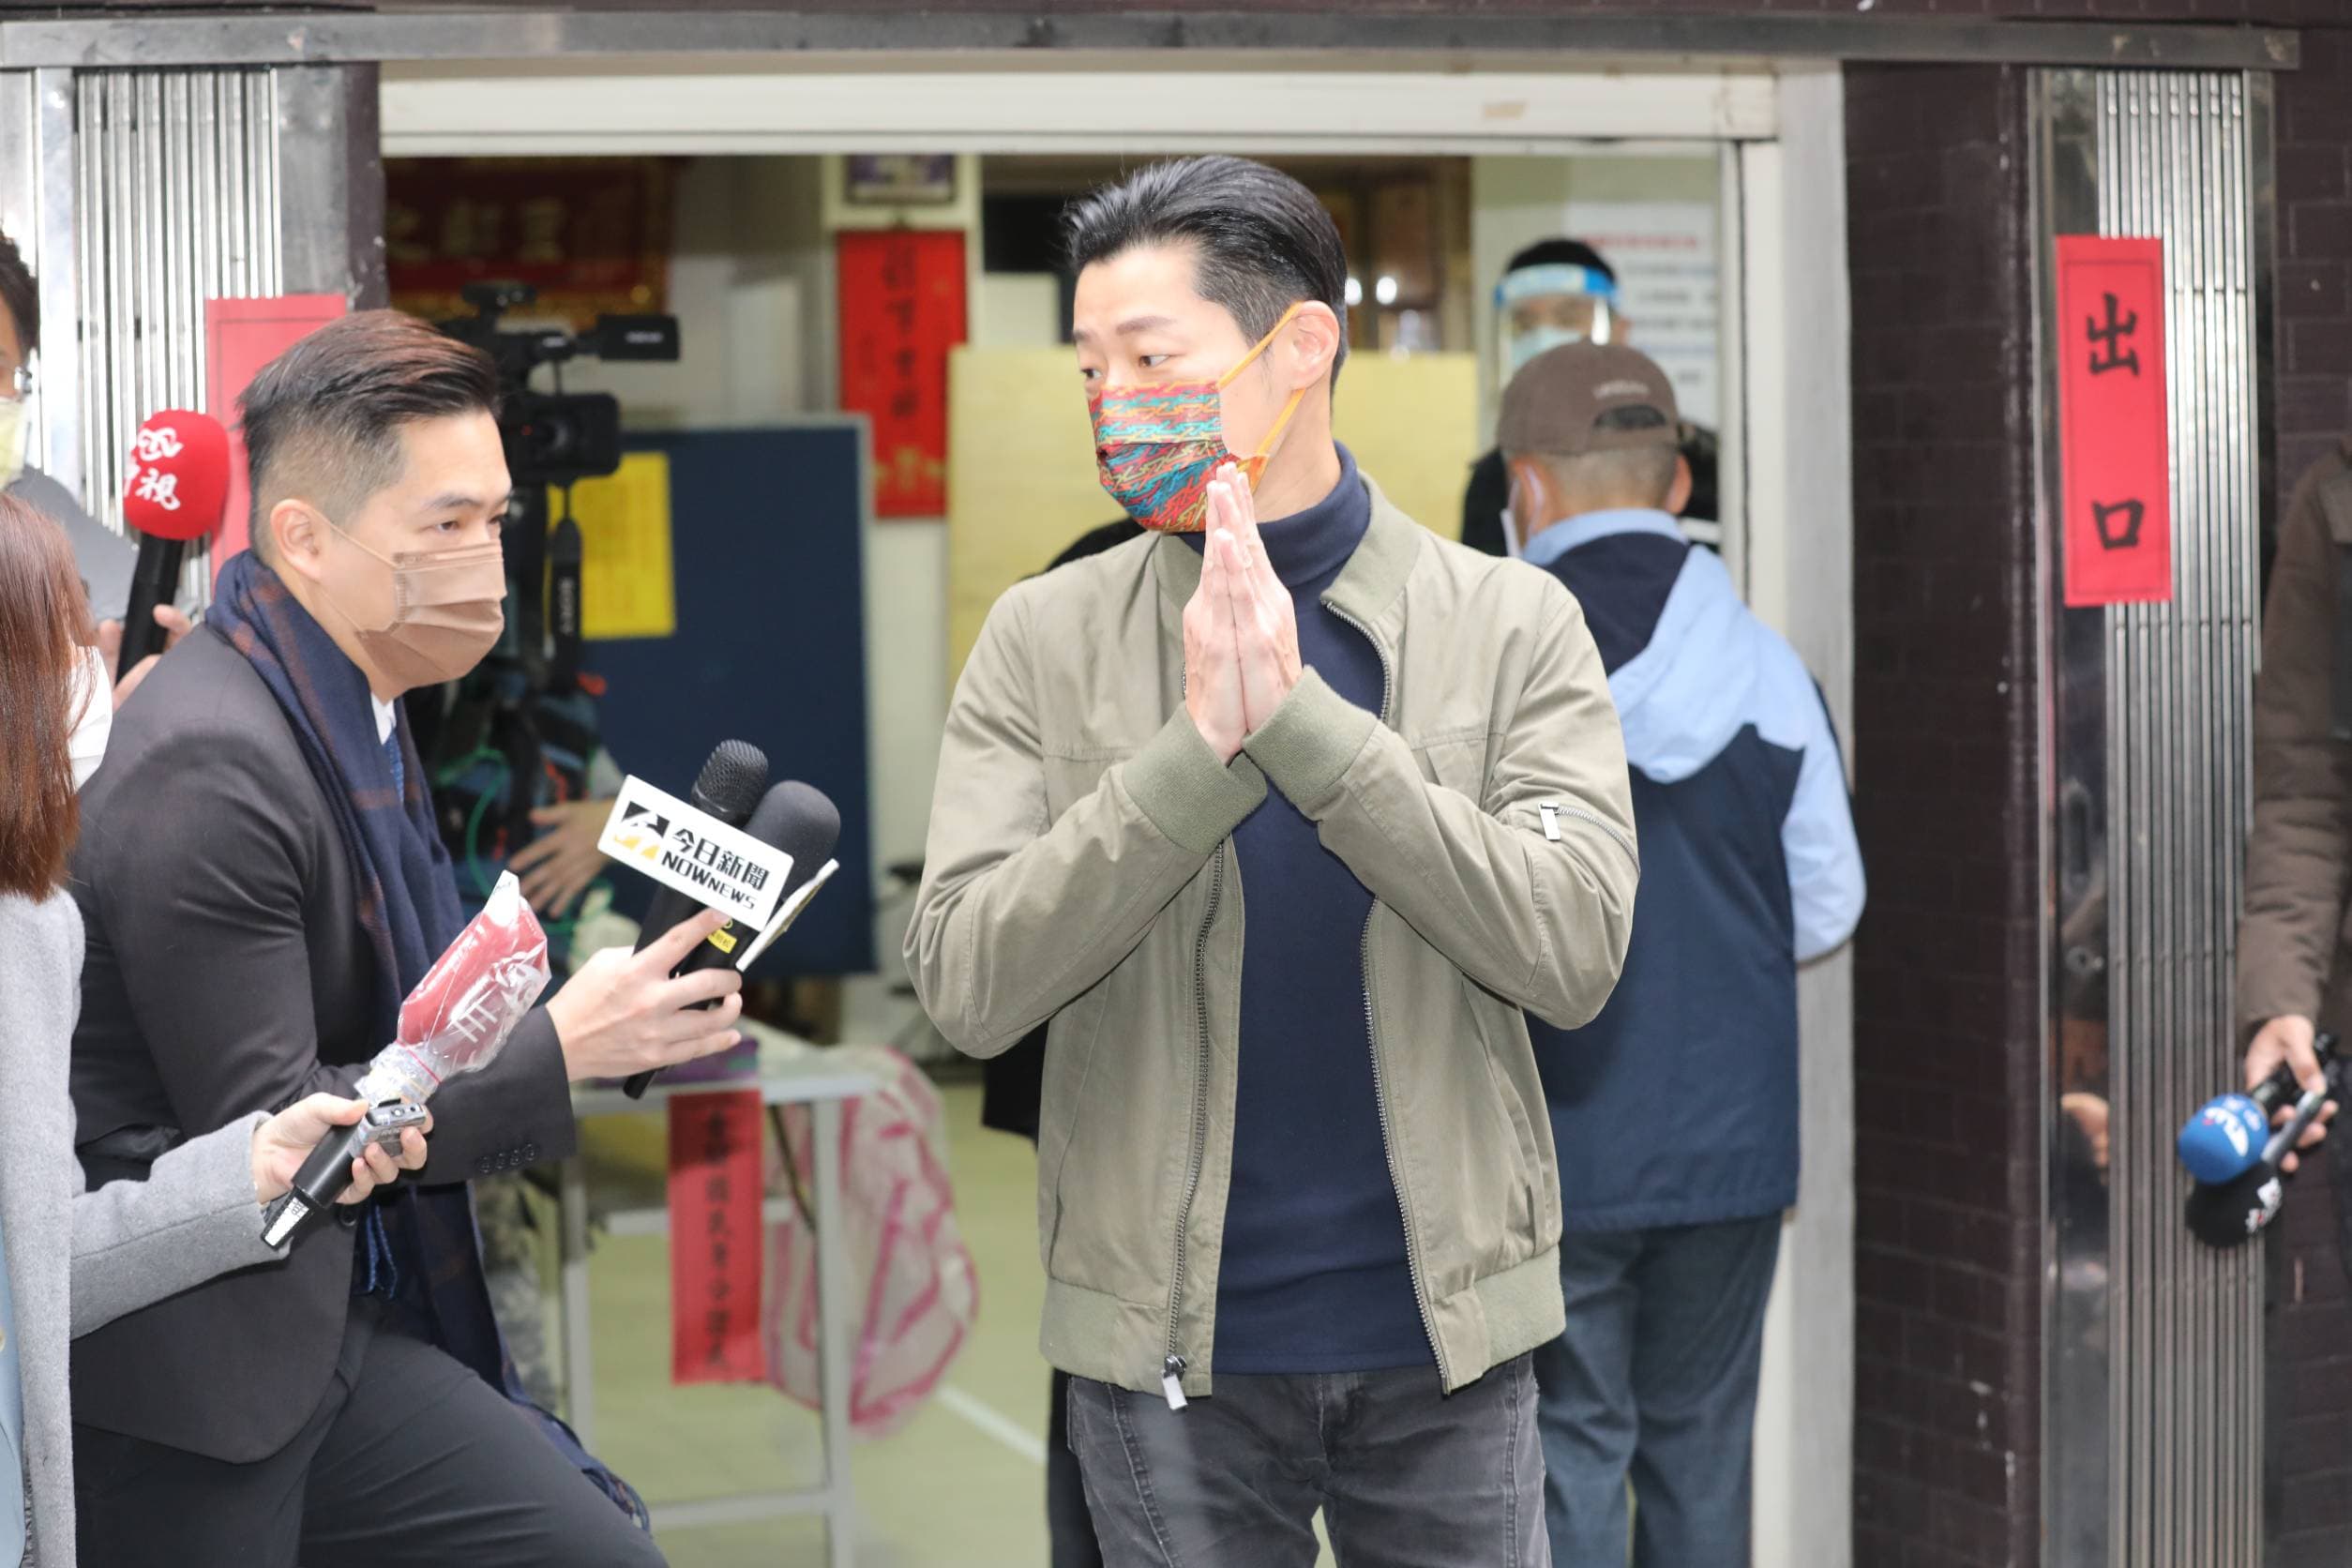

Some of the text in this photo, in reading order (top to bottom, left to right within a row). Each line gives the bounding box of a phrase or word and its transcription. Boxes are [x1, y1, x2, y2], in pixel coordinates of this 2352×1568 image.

[2086, 291, 2146, 551] 出口
[661, 850, 757, 910] NOWNEWS
[672, 828, 770, 891] 今日新聞
